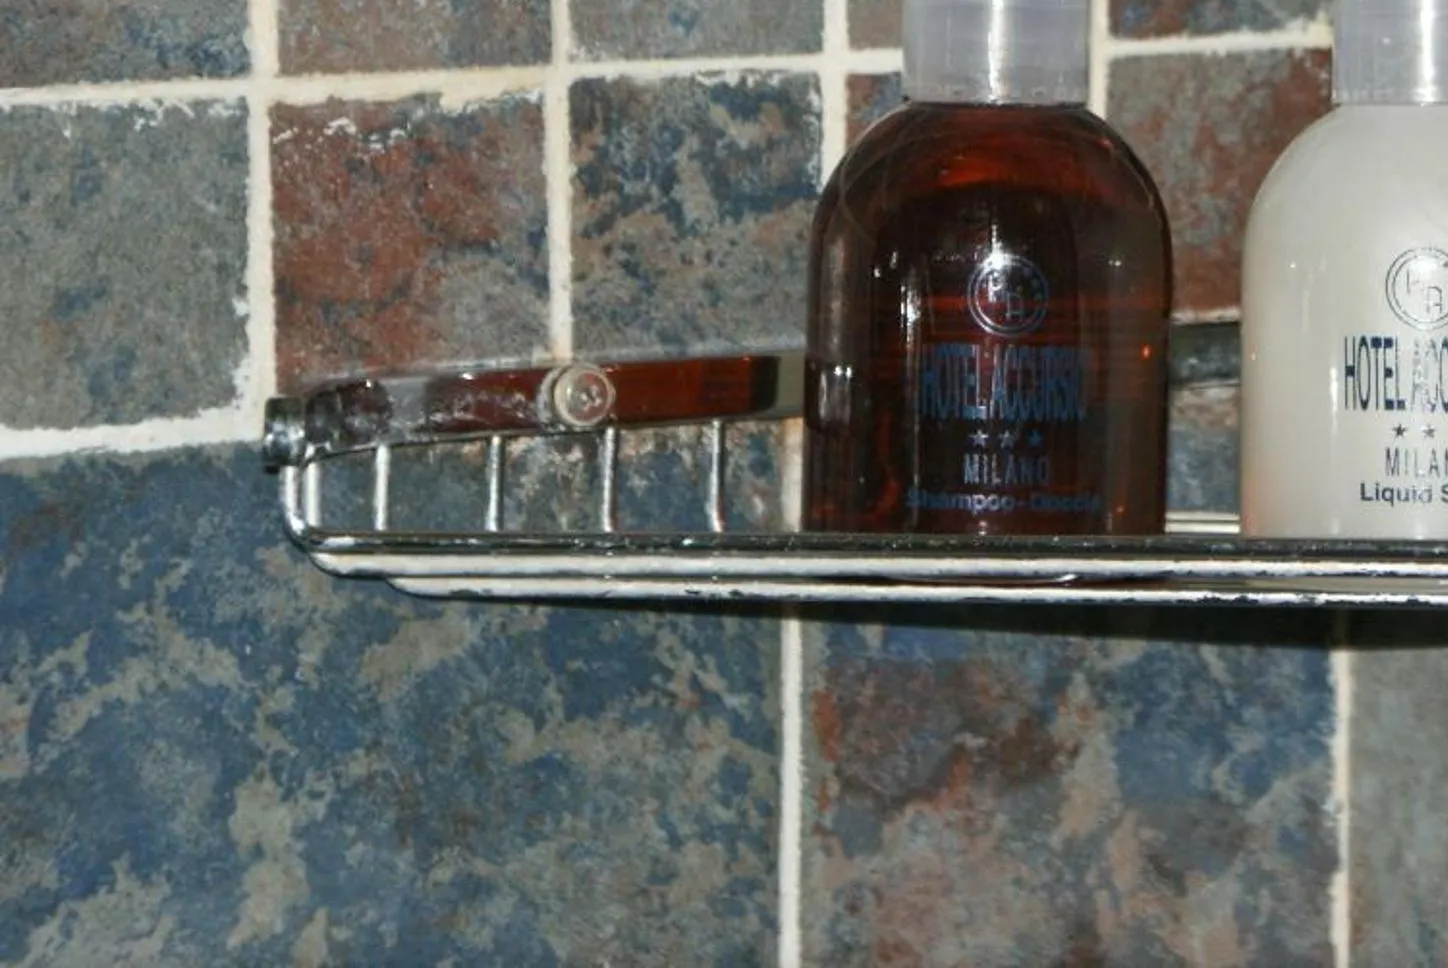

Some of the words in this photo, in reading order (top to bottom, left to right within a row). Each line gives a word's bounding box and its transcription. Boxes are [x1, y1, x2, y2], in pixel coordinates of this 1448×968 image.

[921, 343, 987, 420] HOTEL
[1344, 335, 1407, 411] HOTEL
[963, 453, 1050, 485] MILANO
[1360, 482, 1432, 508] Liquid
